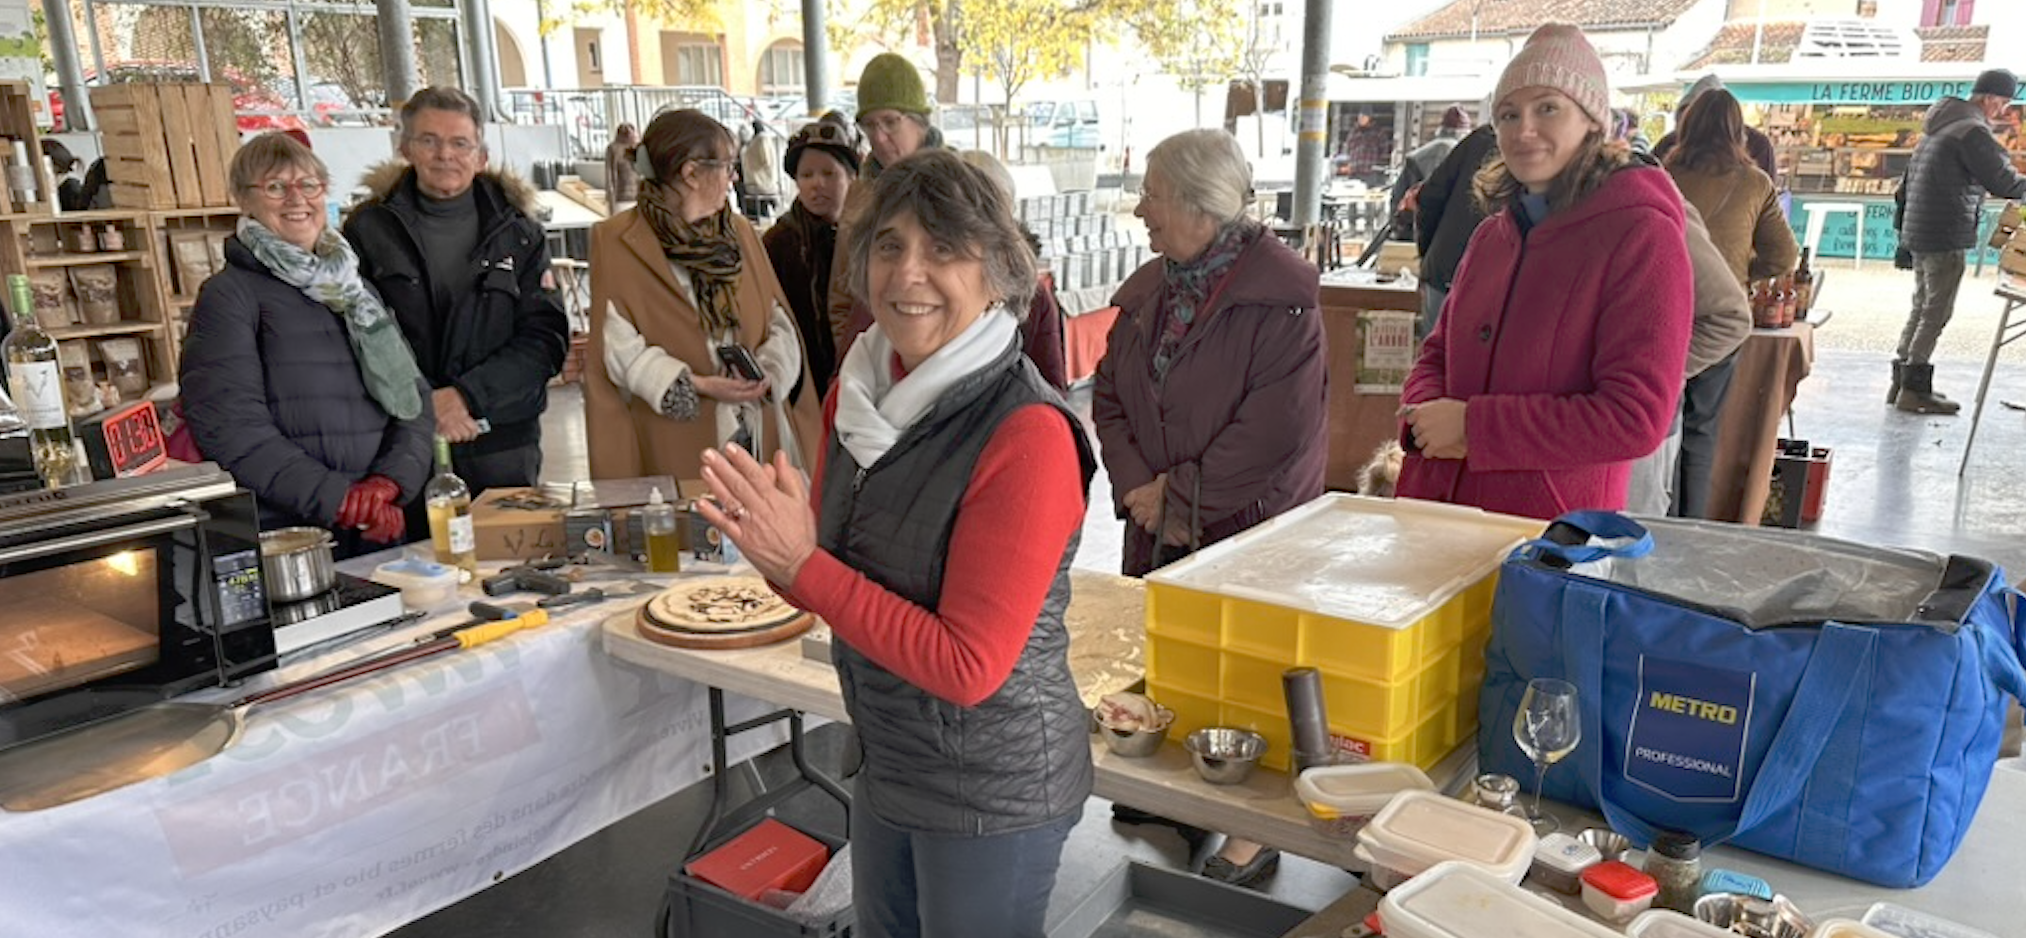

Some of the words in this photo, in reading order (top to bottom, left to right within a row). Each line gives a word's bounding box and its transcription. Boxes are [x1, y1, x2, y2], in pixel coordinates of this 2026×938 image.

[1811, 83, 1832, 101] LA
[1839, 82, 1893, 101] FERME
[1902, 82, 1934, 101] BIO
[1649, 691, 1737, 725] METRO
[1635, 746, 1732, 779] PROFESSIONAL
